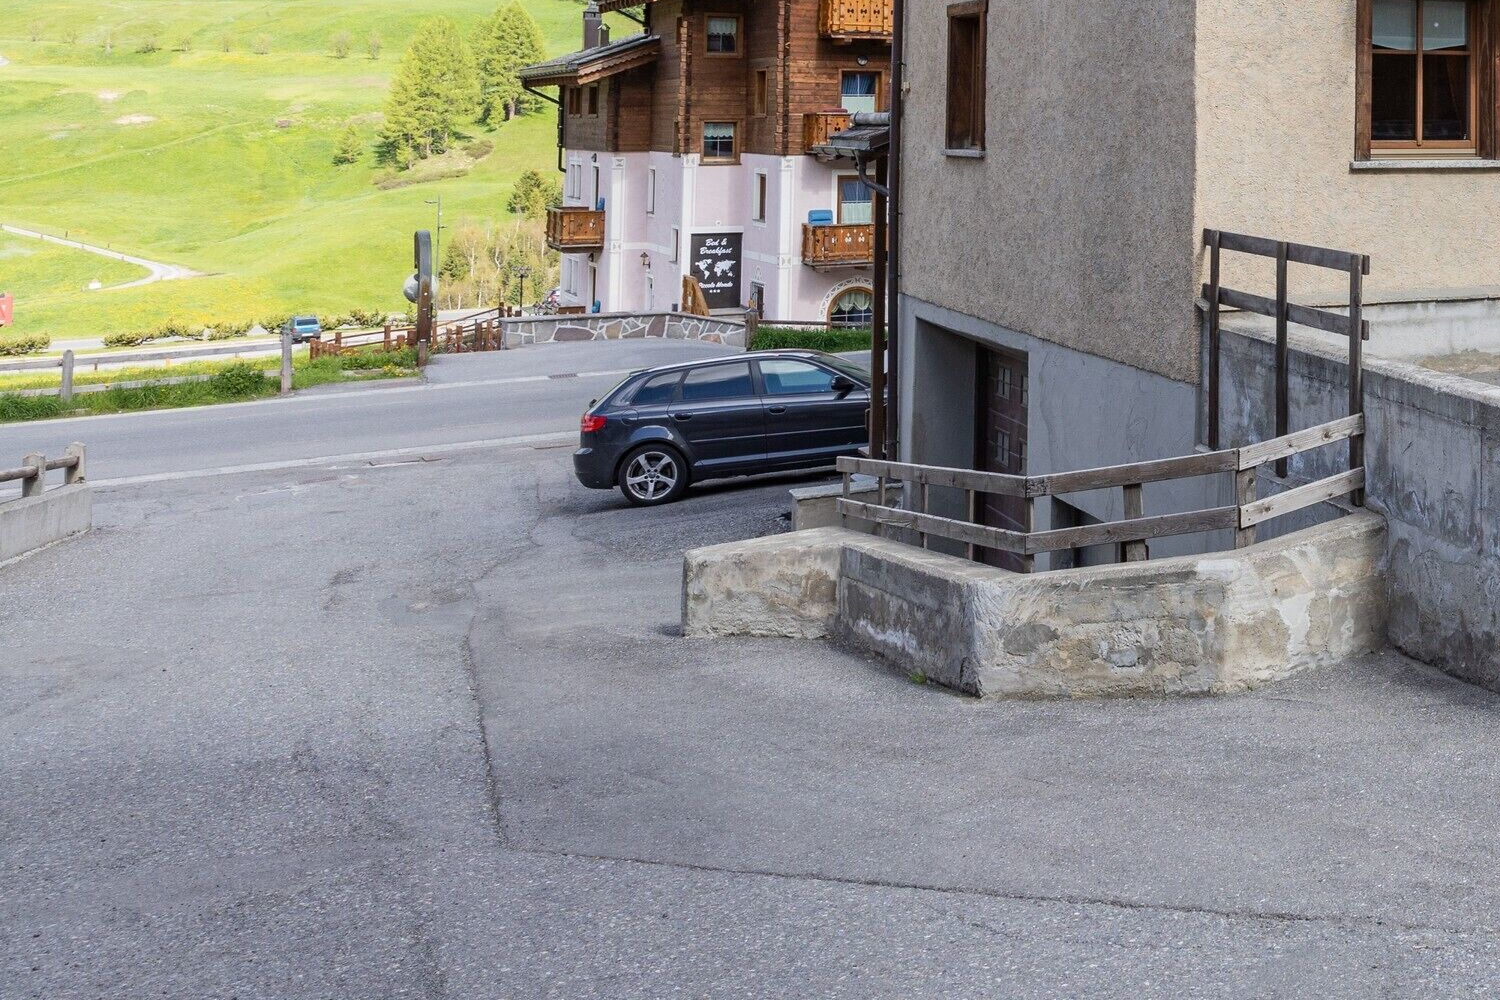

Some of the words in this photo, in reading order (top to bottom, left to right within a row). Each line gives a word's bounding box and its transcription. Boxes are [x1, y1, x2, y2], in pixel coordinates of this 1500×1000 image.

[705, 238, 720, 246] Bed
[721, 238, 728, 246] &
[699, 246, 733, 256] Breakfast
